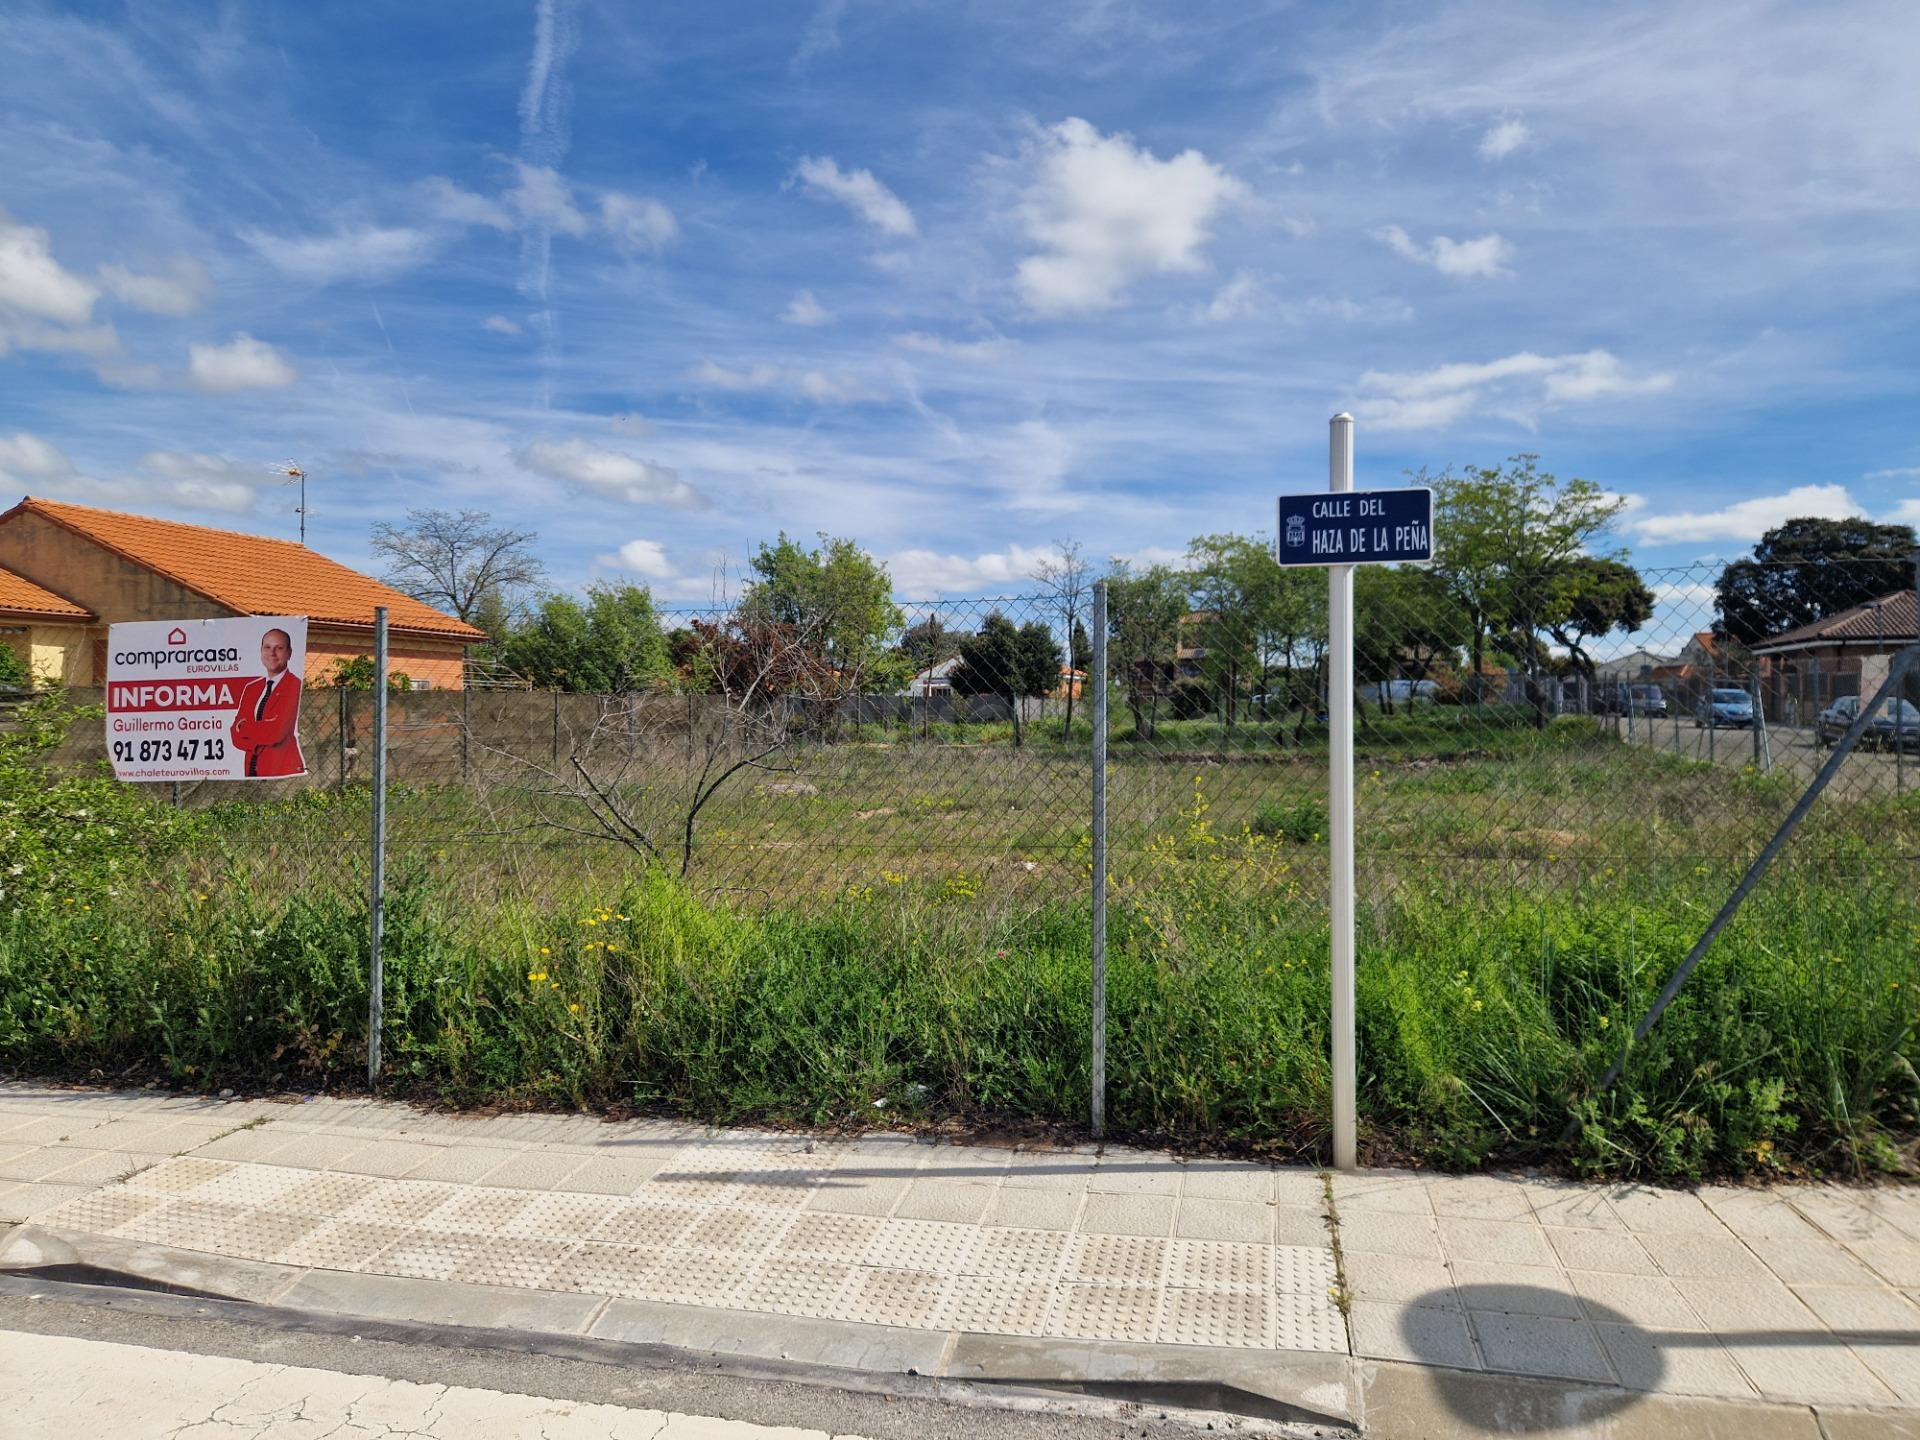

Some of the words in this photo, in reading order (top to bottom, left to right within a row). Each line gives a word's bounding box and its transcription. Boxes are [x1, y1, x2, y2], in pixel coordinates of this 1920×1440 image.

[1313, 501, 1351, 518] CALLE
[1360, 499, 1385, 516] DEL
[1313, 529, 1344, 554] HAZA
[1350, 528, 1366, 553] DE
[1374, 527, 1389, 552] LA
[1395, 520, 1428, 551] PEÑA
[186, 664, 239, 673] EUROVILLAS
[113, 683, 235, 708] INFORMA
[113, 718, 175, 732] Guillermo
[113, 741, 134, 762] 91
[139, 740, 172, 762] 873
[177, 739, 199, 761] 47
[204, 738, 225, 761] 13
[118, 767, 231, 778] www.chaleteurovillas.com
